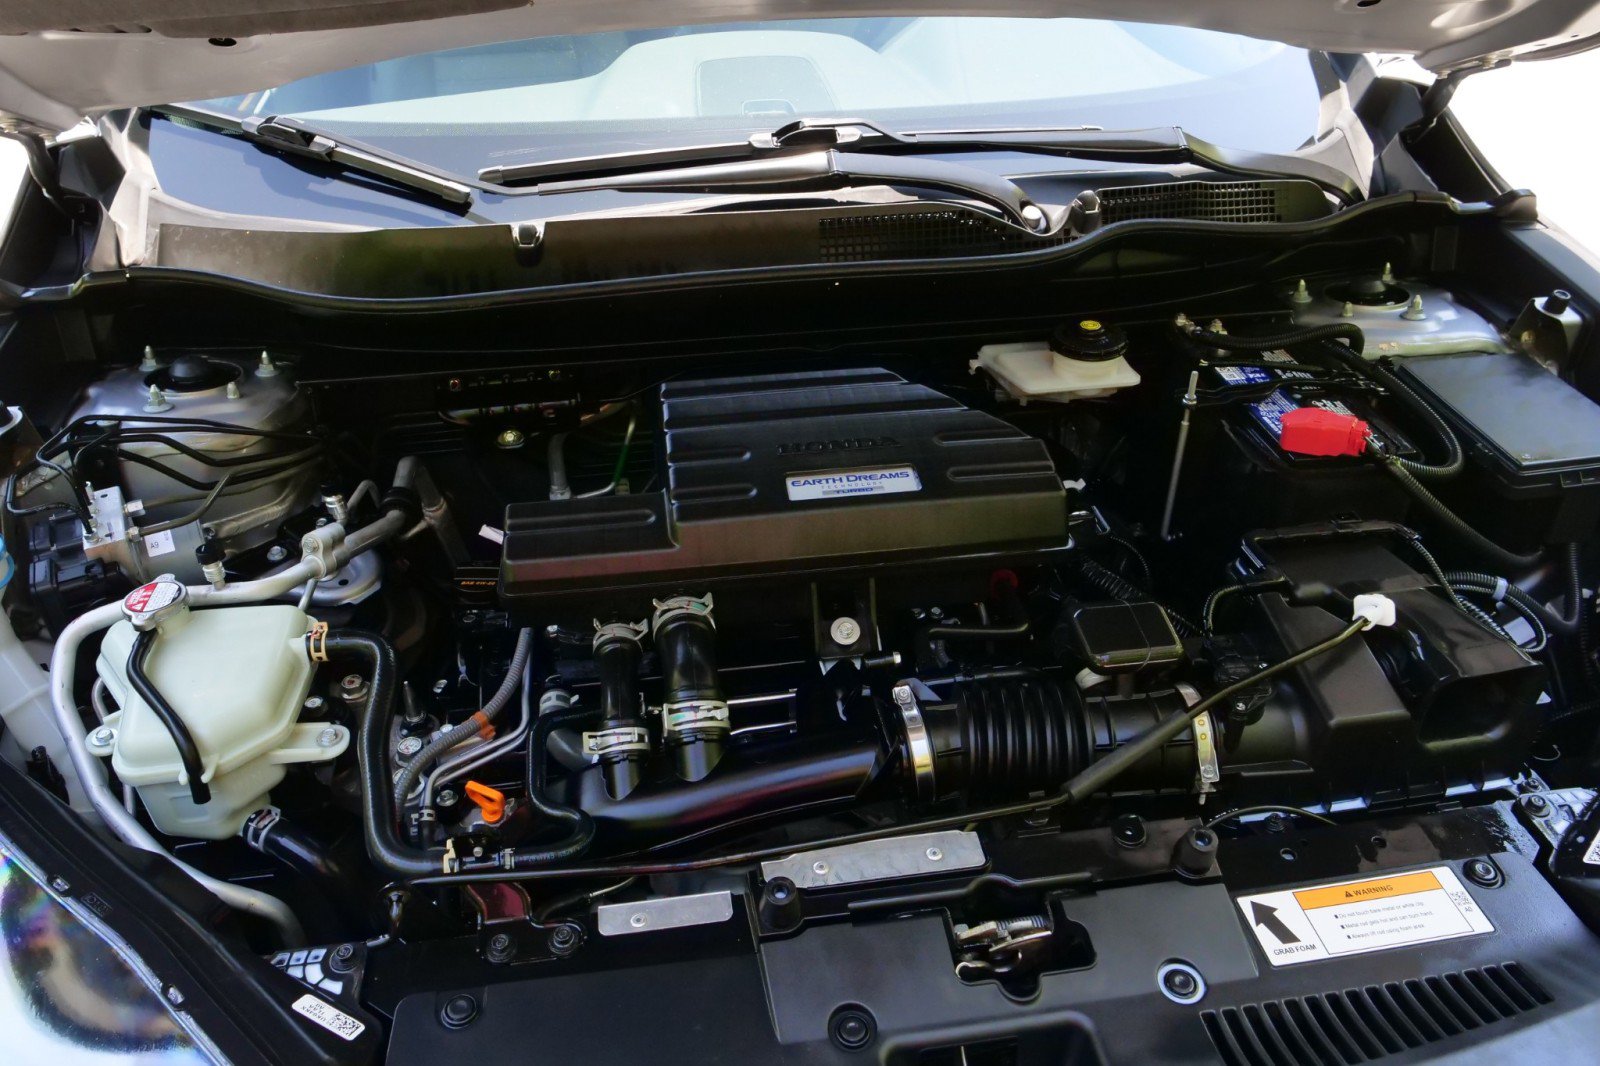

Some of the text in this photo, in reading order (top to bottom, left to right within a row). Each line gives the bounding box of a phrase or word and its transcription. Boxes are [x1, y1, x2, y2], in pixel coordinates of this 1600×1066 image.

[776, 436, 903, 455] HONDA
[791, 471, 910, 487] EARTH DREAMS
[835, 487, 874, 495] TURBO
[1353, 884, 1393, 896] WARNING
[1274, 944, 1317, 956] GRAB FOAM
